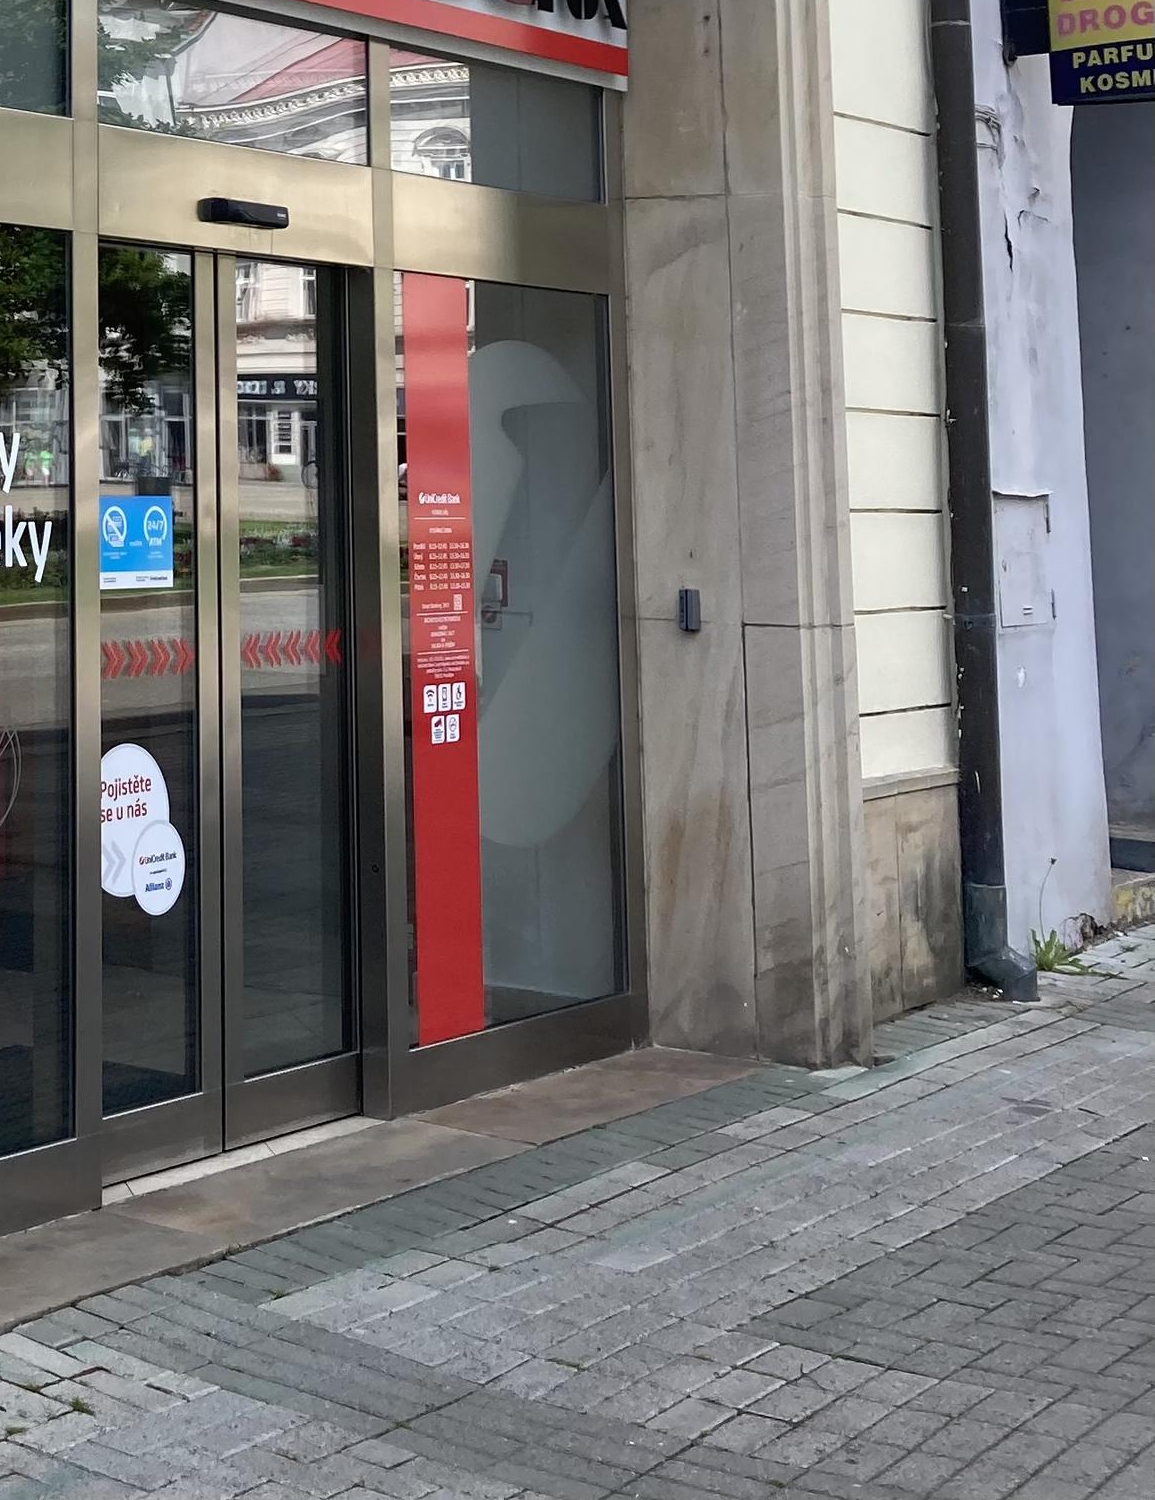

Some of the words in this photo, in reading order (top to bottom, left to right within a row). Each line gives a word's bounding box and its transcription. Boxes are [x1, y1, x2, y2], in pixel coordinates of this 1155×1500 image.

[1079, 69, 1155, 94] KOSM
[147, 519, 164, 531] 24/7
[100, 774, 152, 802] Pojistěte
[116, 806, 123, 821] u
[127, 798, 148, 819] nás
[145, 882, 165, 893] Allianz
